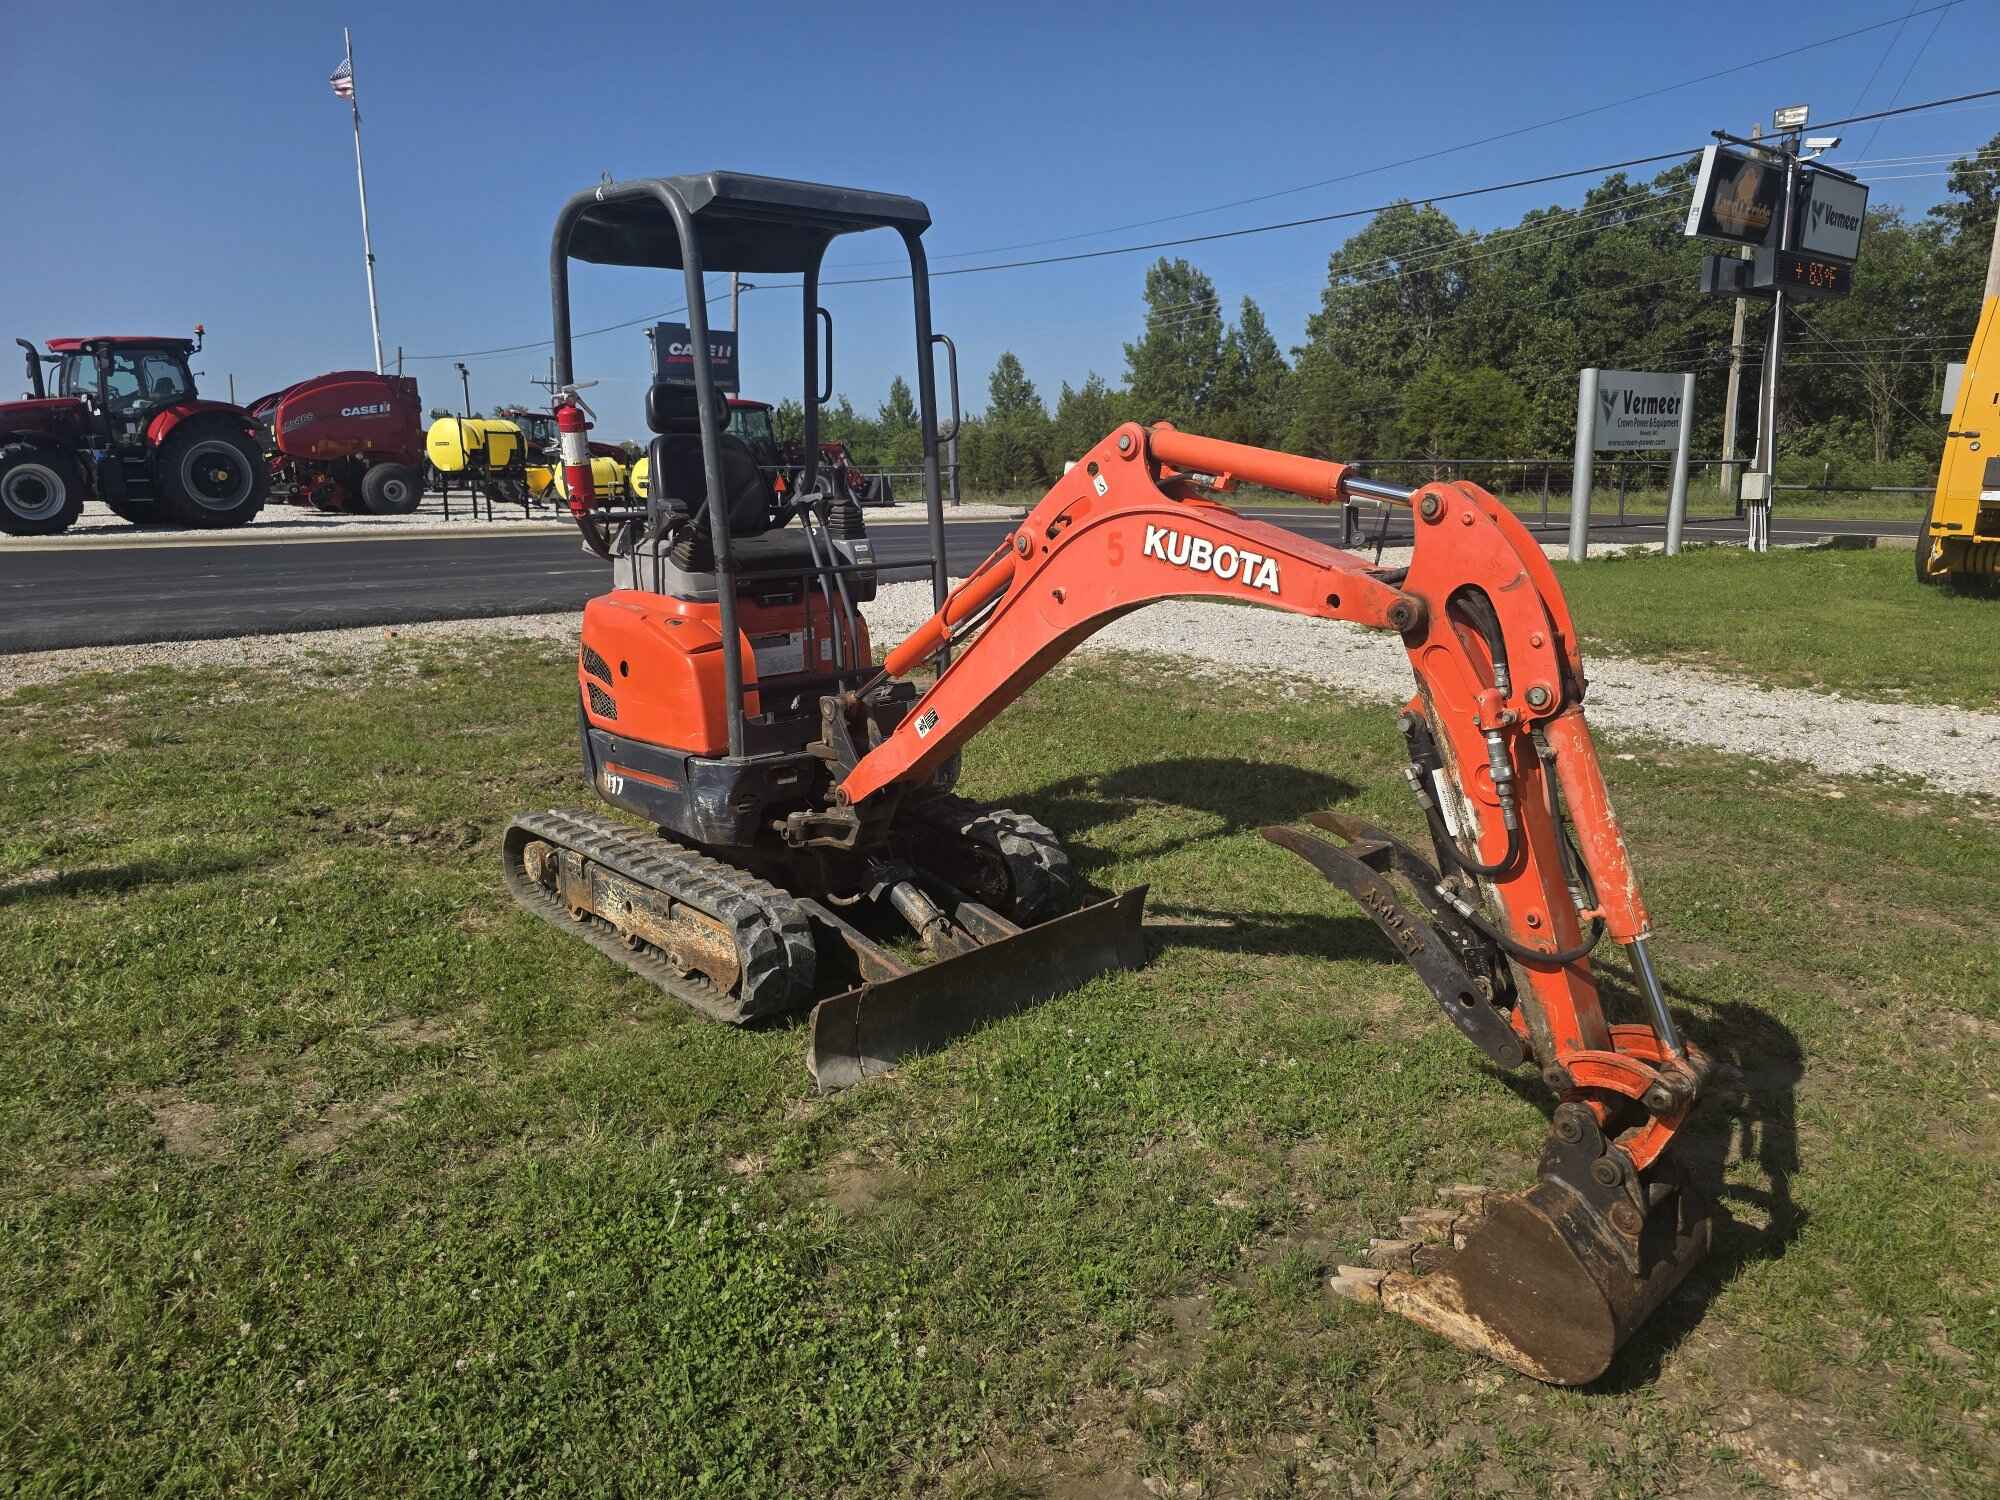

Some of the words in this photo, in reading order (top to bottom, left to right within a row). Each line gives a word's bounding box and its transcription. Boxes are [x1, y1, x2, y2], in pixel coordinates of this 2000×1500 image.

[1825, 204, 1859, 232] Vermeer
[668, 343, 717, 356] CAE
[340, 405, 377, 417] CASE
[1623, 390, 1680, 414] Vermeer
[1142, 524, 1281, 594] KUBOTA
